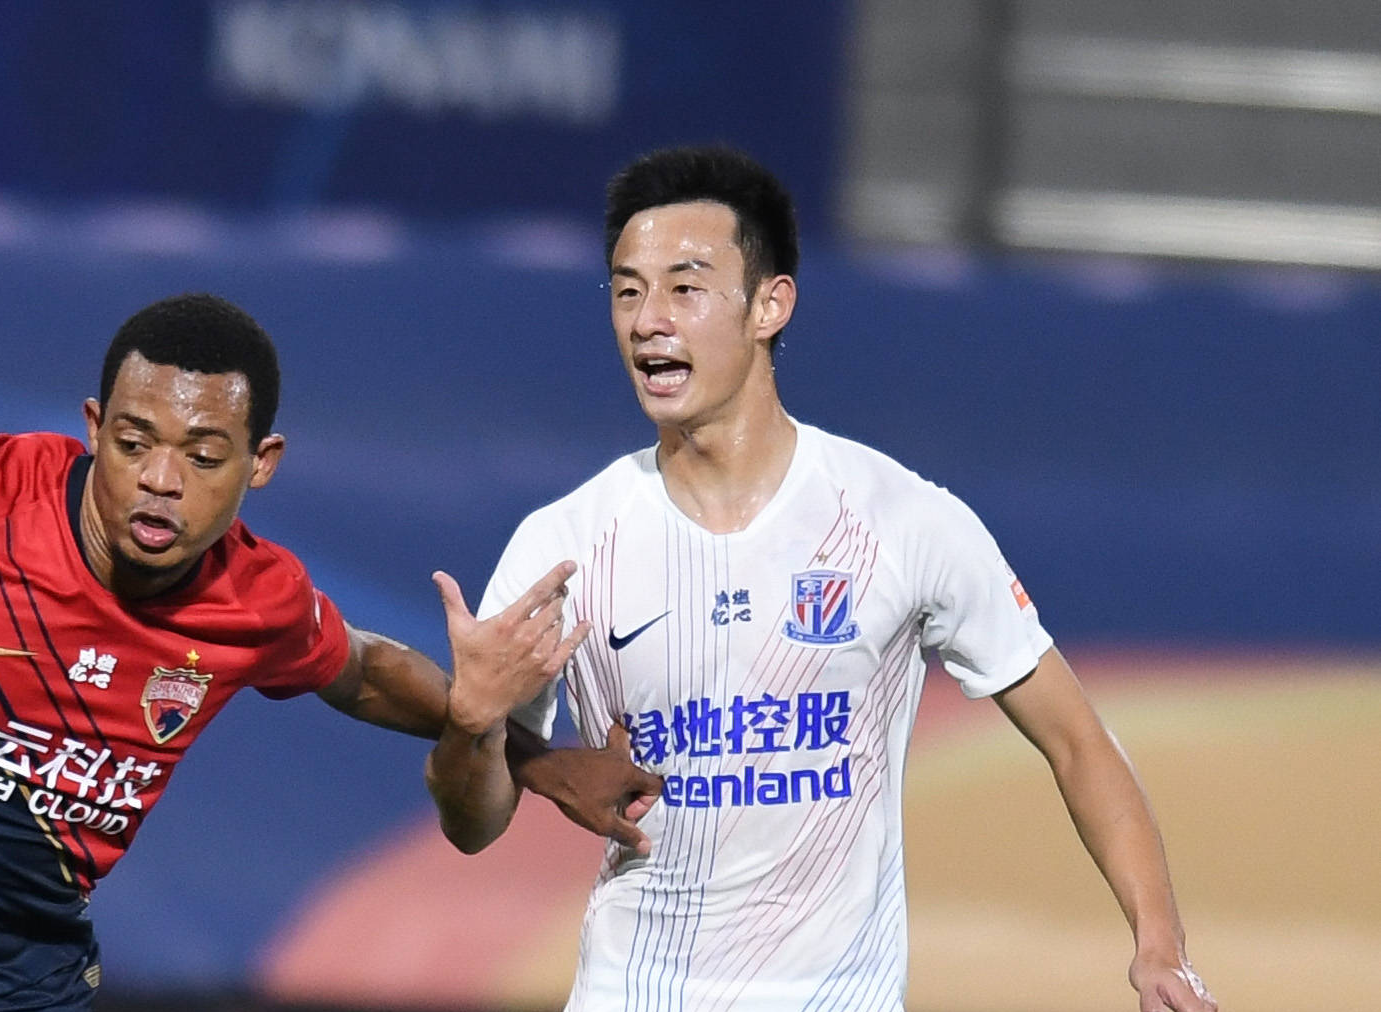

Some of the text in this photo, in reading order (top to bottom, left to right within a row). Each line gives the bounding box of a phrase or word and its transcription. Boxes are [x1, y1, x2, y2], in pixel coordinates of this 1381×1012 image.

[623, 691, 852, 765] 绿地控股
[662, 757, 852, 808] eenland
[28, 789, 129, 836] CLOUD
